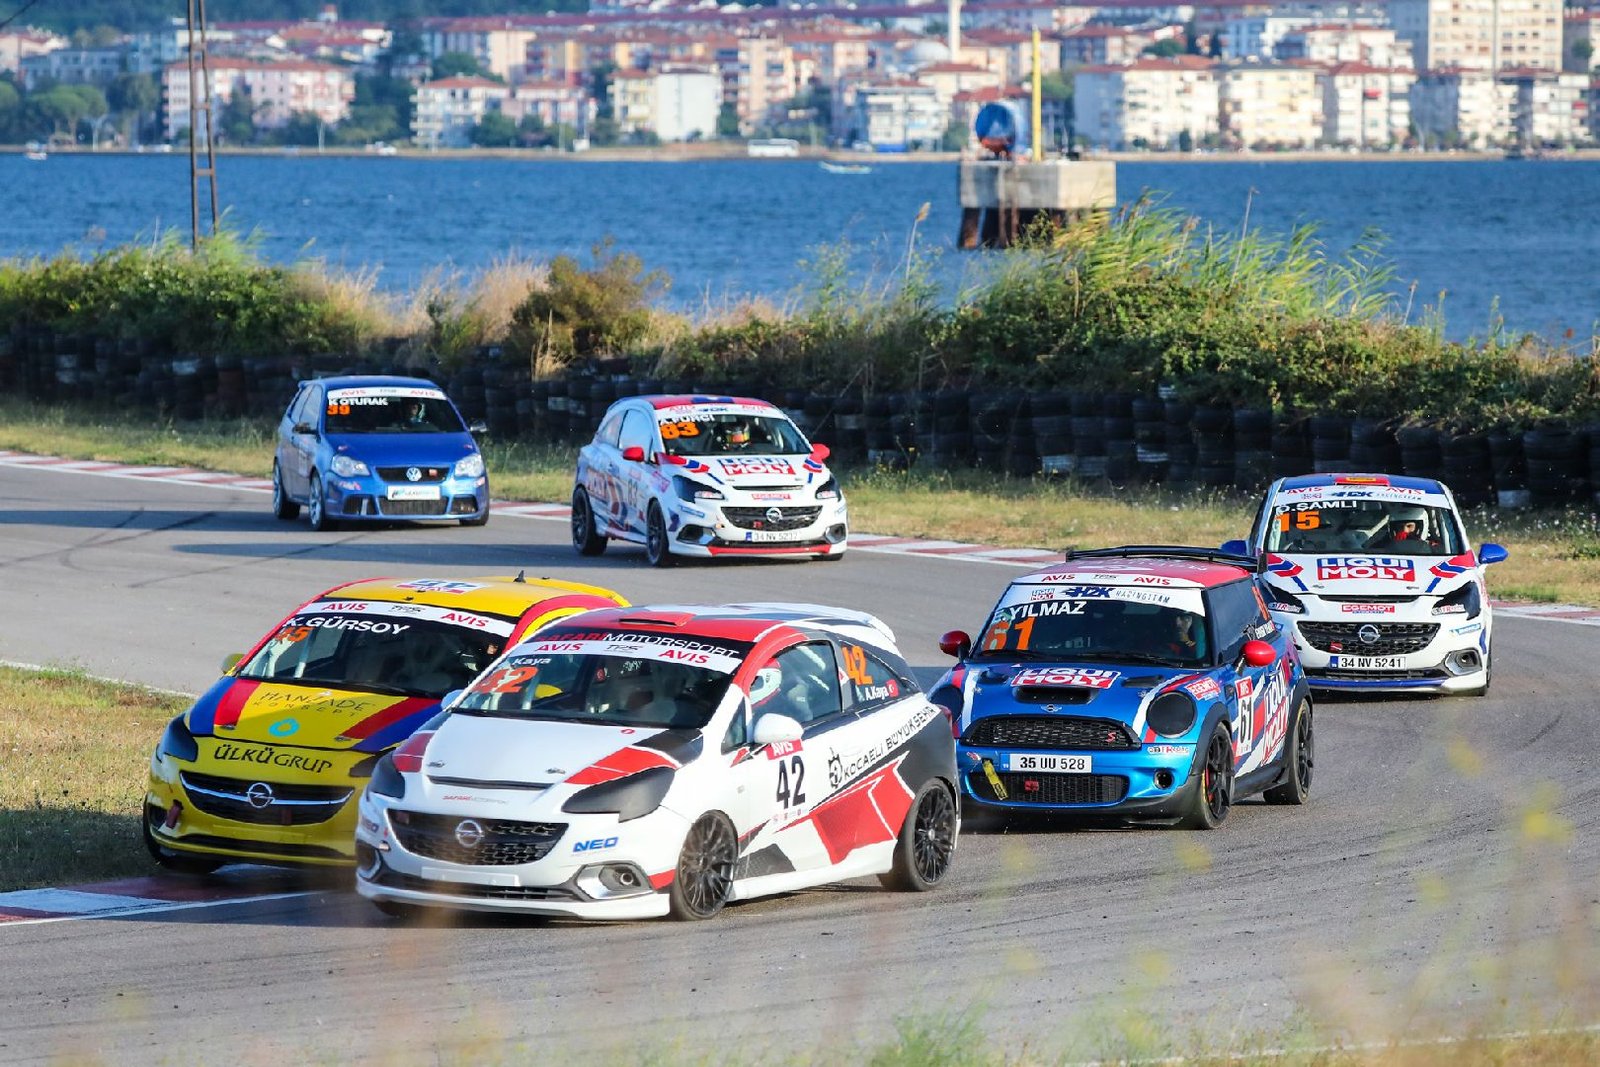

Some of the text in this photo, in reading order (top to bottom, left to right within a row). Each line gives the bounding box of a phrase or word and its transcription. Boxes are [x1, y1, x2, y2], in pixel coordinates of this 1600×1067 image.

[660, 421, 700, 440] 83
[725, 464, 793, 475] MOLY
[1287, 486, 1323, 495] AVIS
[1385, 487, 1422, 495] AVIS
[1274, 510, 1321, 532] 15
[1321, 558, 1413, 569] LIQUI
[1041, 573, 1076, 583] AVIS
[1132, 576, 1172, 587] AVIS
[1322, 567, 1414, 581] MOLY
[321, 602, 369, 612] AVIS
[440, 612, 490, 629] AVIS
[1342, 604, 1395, 613] EGEMOT
[982, 616, 1037, 652] 61
[512, 656, 552, 667] Kaya
[536, 643, 584, 652] AVIS
[658, 649, 711, 665] AVIS
[842, 645, 874, 686] 42
[1341, 657, 1402, 669] 34 NV 5241
[1018, 675, 1108, 688] MOLY
[1240, 698, 1252, 744] 61
[771, 741, 795, 757] AVIS
[1019, 757, 1037, 770] 35
[1040, 757, 1057, 770] UU
[1060, 757, 1085, 771] 528
[776, 755, 806, 810] 42
[572, 836, 619, 853] NEO
